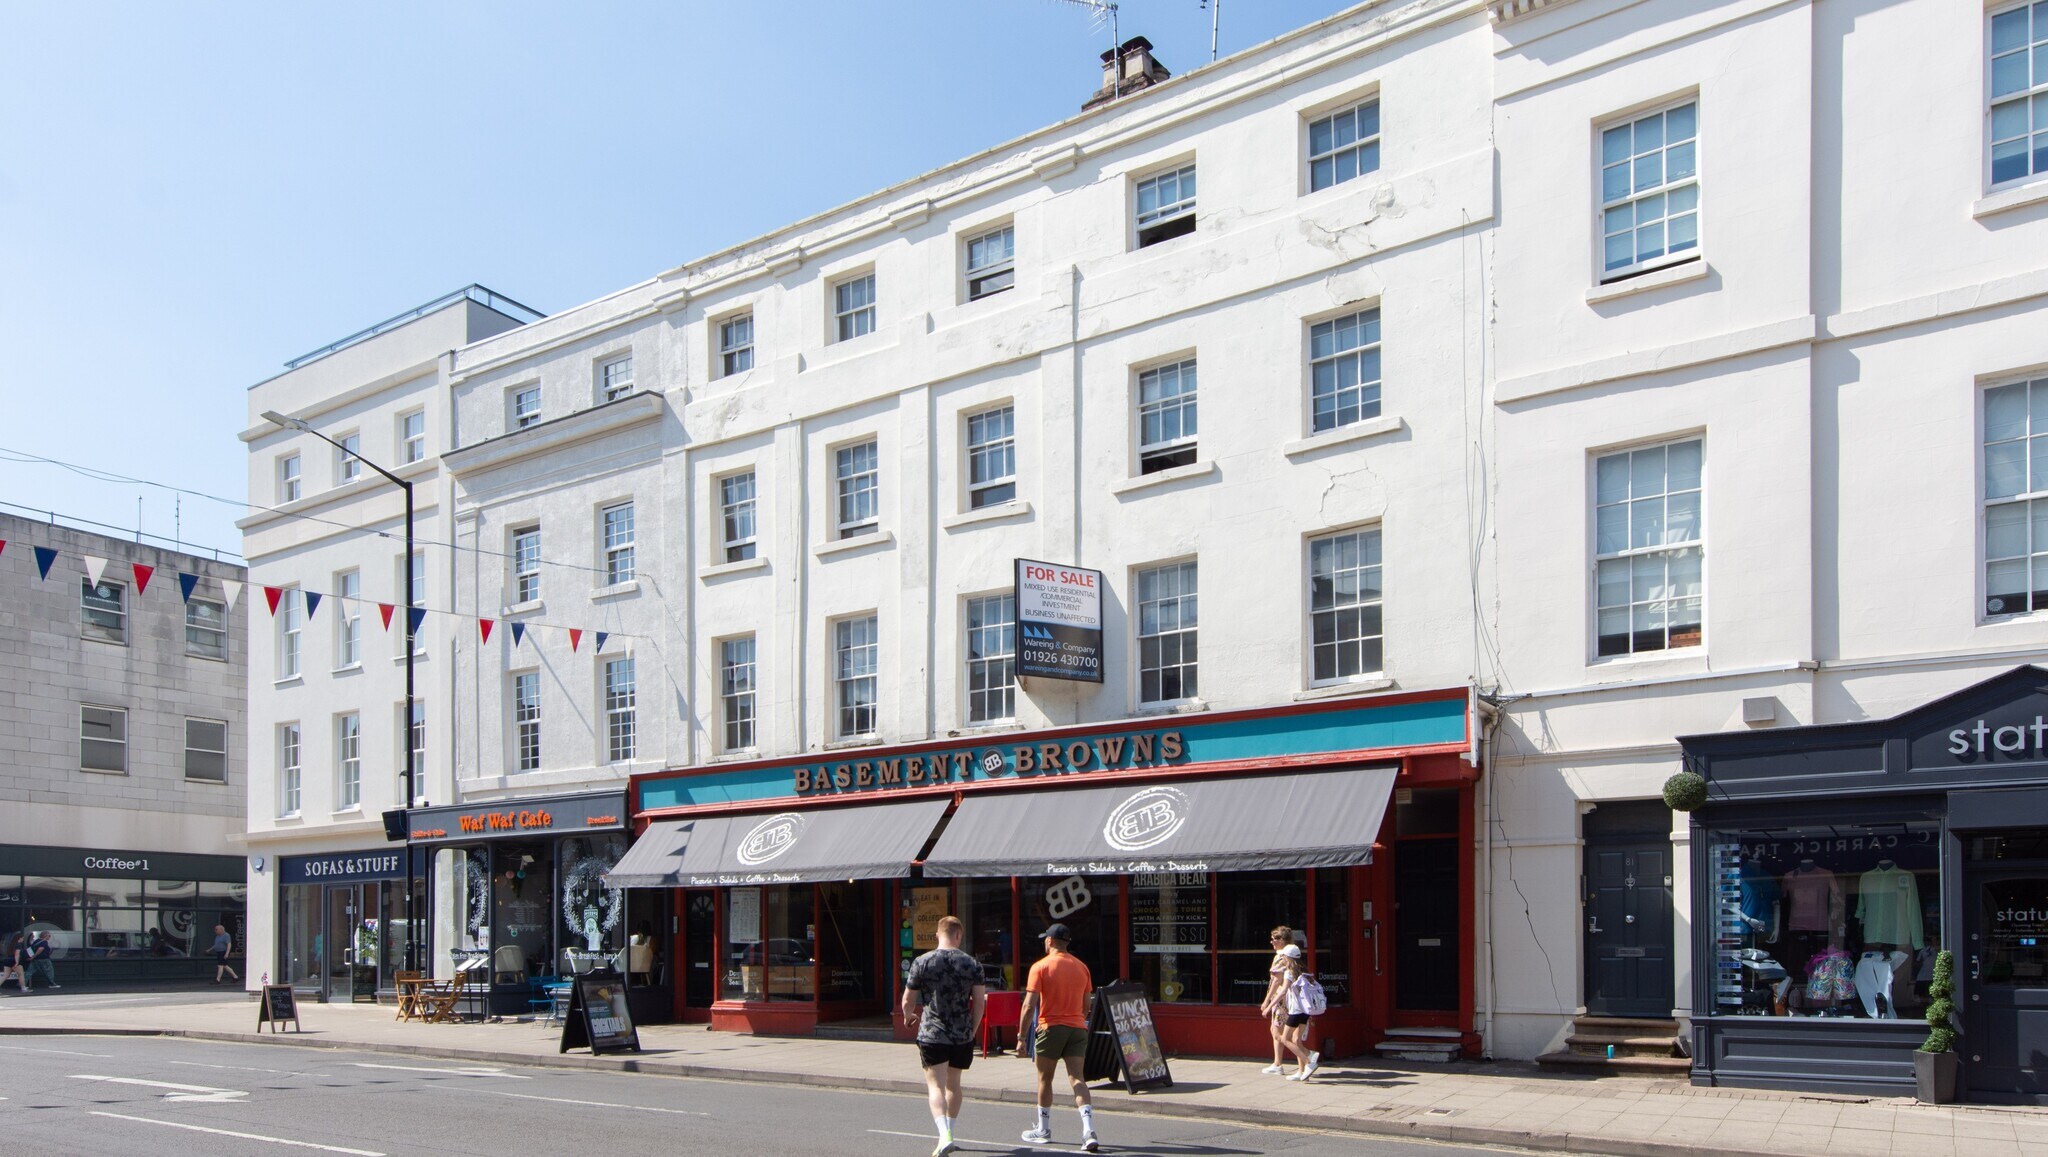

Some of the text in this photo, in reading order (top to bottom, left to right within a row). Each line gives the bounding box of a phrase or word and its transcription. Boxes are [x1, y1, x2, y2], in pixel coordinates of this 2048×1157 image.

[1026, 566, 1094, 588] FOR SALE
[1024, 583, 1046, 591] MIXED
[1060, 587, 1096, 599] RESIDENTIAL
[1042, 601, 1081, 611] INVESTMENT
[1025, 609, 1096, 624] BUSINESS UNAFFECTED
[1024, 638, 1095, 655] Wareing & Company
[1024, 650, 1098, 668] 01926 430700
[1024, 664, 1098, 677] wareingandcompany.co.uk
[793, 751, 973, 792] BASEMENT
[1013, 732, 1182, 772] BROWNS
[459, 810, 551, 832] Waf Waf Cafe
[1047, 860, 1208, 873] Pizzeria Salads Coffee Desserts
[1625, 857, 1634, 866] 81
[691, 873, 800, 885] Pizzeria Salads Coffee Desserts
[1133, 872, 1207, 886] ARABICA BEAN
[1134, 927, 1207, 942] ESPRESSO
[1110, 998, 1149, 1022] LUNCH
[591, 1017, 626, 1034] COCKTAILS
[1115, 1015, 1153, 1034] BIG DEAL
